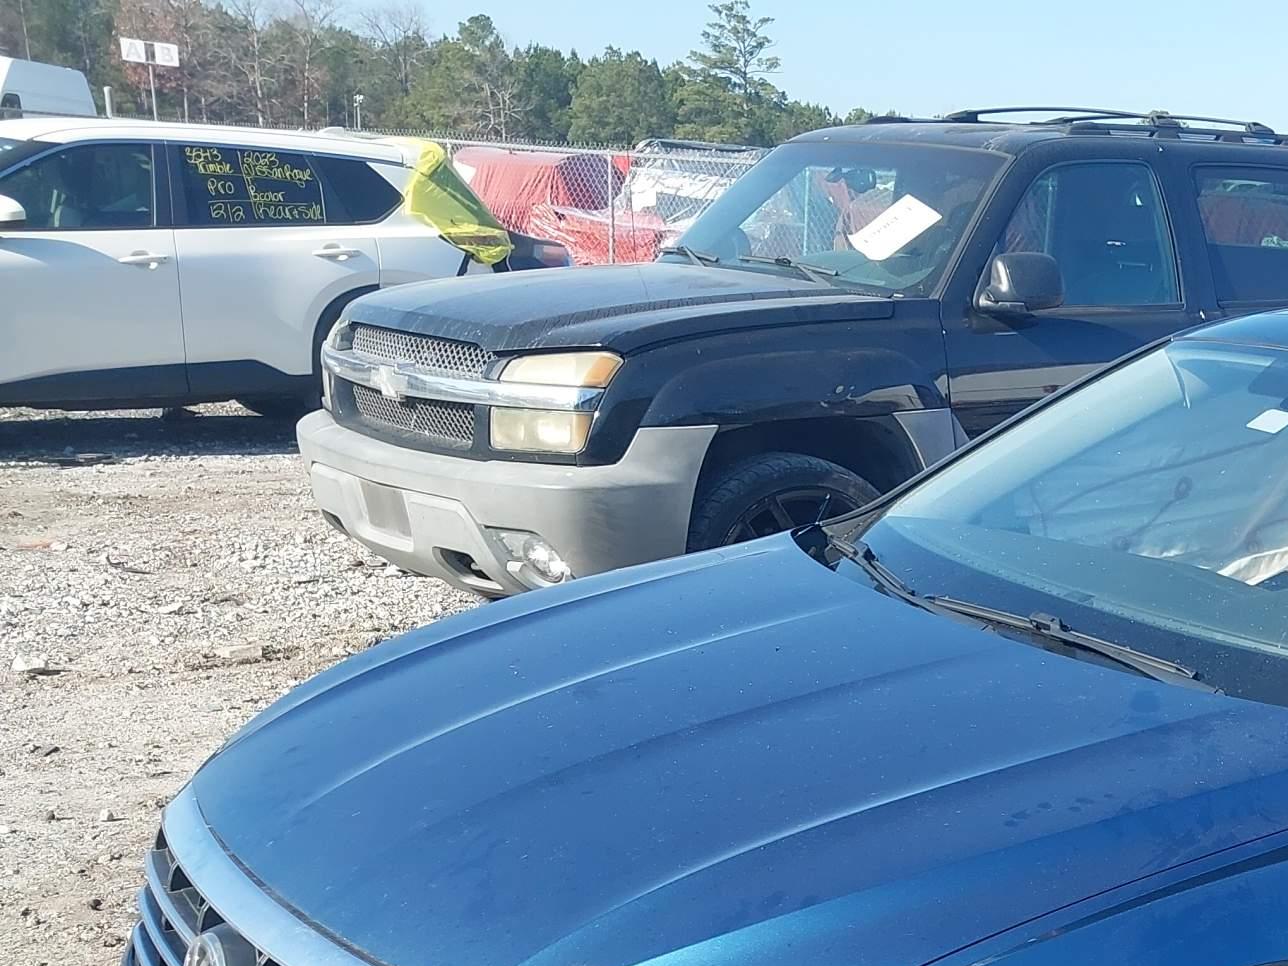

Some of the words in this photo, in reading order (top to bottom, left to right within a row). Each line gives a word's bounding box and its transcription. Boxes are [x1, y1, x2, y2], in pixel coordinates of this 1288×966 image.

[126, 41, 142, 58] A
[161, 46, 174, 62] B
[244, 151, 280, 168] 2023
